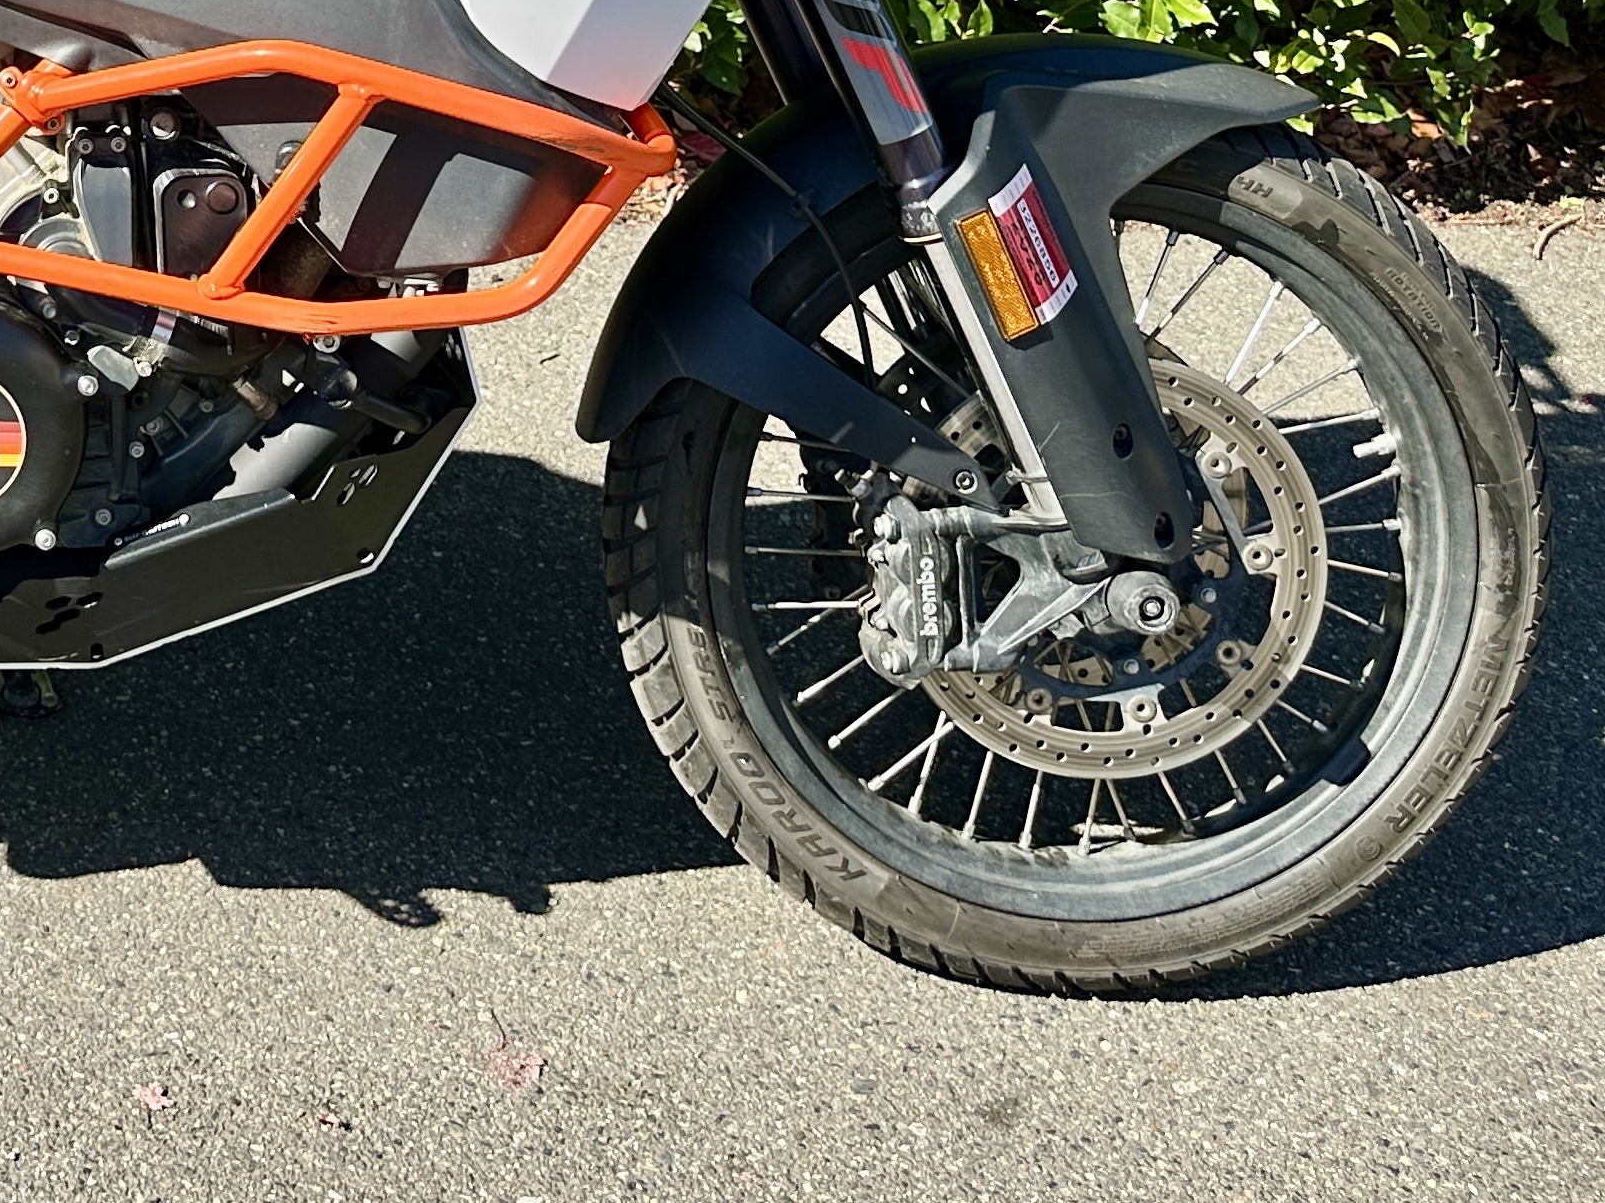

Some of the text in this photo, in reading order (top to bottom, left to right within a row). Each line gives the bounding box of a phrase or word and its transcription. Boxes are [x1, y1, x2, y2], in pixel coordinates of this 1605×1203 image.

[916, 556, 939, 637] brembo
[1383, 636, 1510, 835] METZELER
[728, 750, 868, 882] KAROO
